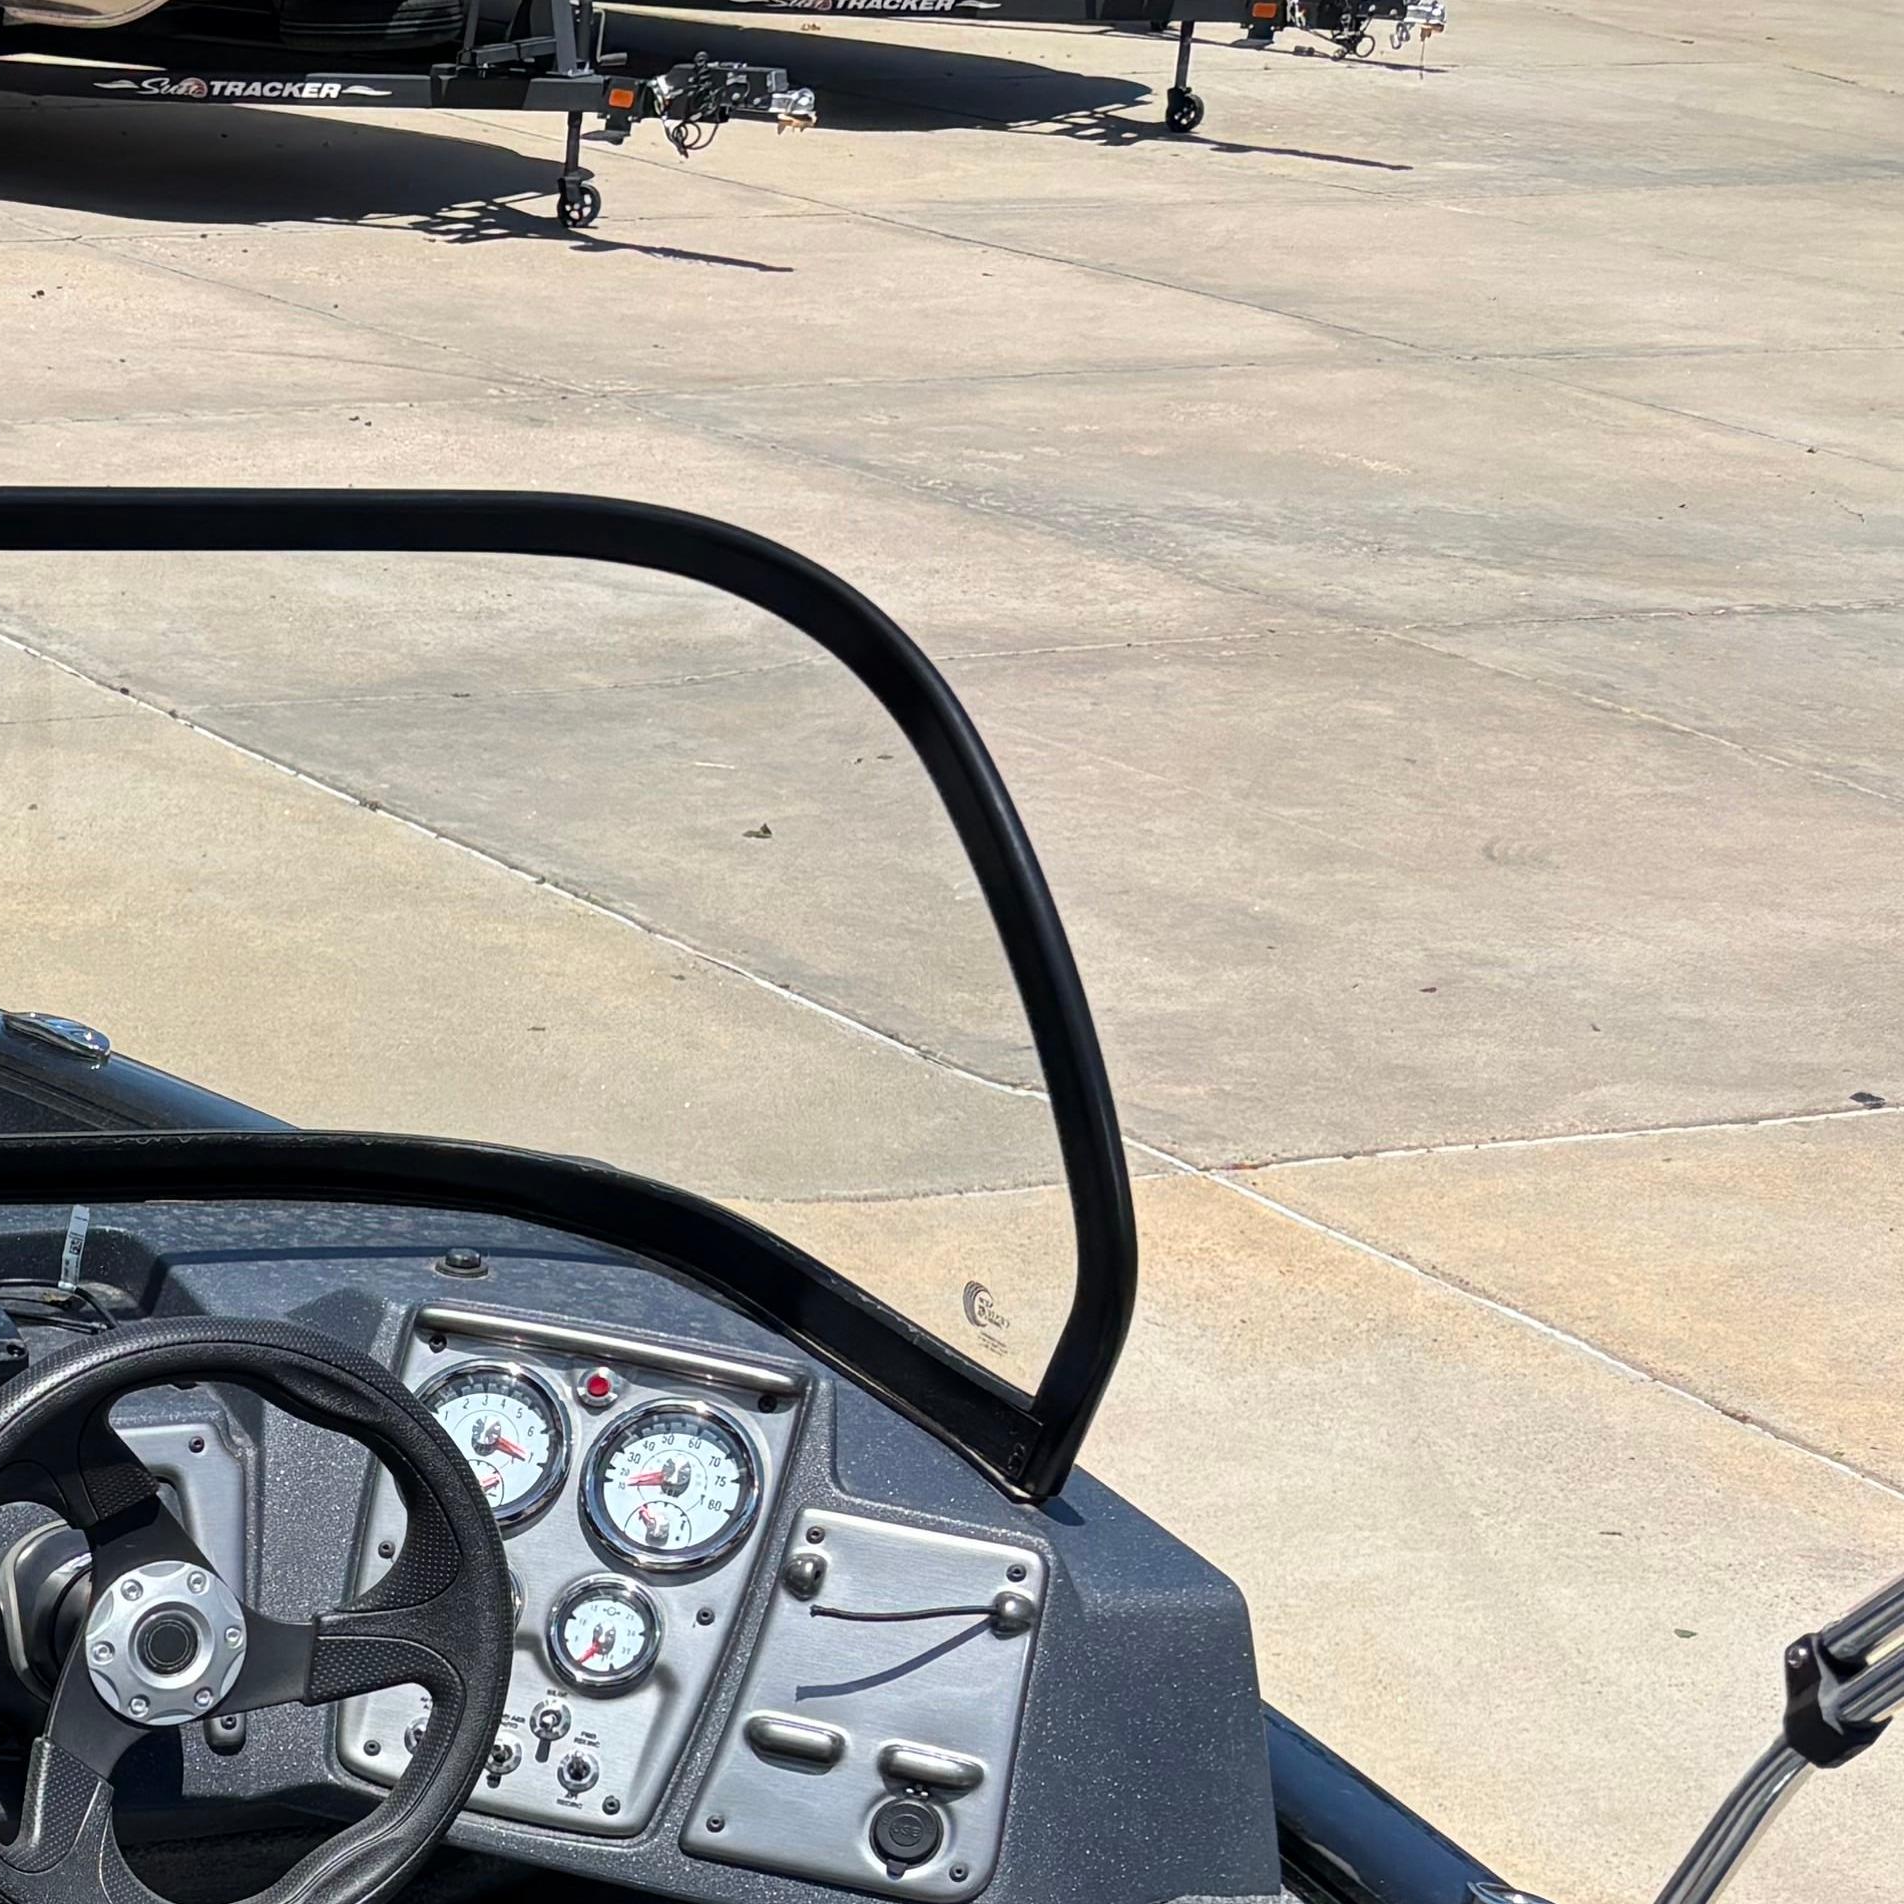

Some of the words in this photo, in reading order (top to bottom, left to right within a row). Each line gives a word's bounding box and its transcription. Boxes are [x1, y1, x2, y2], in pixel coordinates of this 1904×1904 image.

[210, 81, 342, 99] TRACKER
[463, 1398, 469, 1409] 2
[482, 1395, 488, 1406] 3
[500, 1398, 507, 1408] 4
[516, 1408, 523, 1419] 5
[528, 1426, 534, 1437] 6
[662, 1435, 675, 1445] 50
[688, 1437, 702, 1449] 60
[643, 1441, 656, 1451] 40
[627, 1451, 641, 1464] 30
[709, 1456, 721, 1467] 70
[714, 1475, 726, 1487] 75
[708, 1499, 722, 1511] 80
